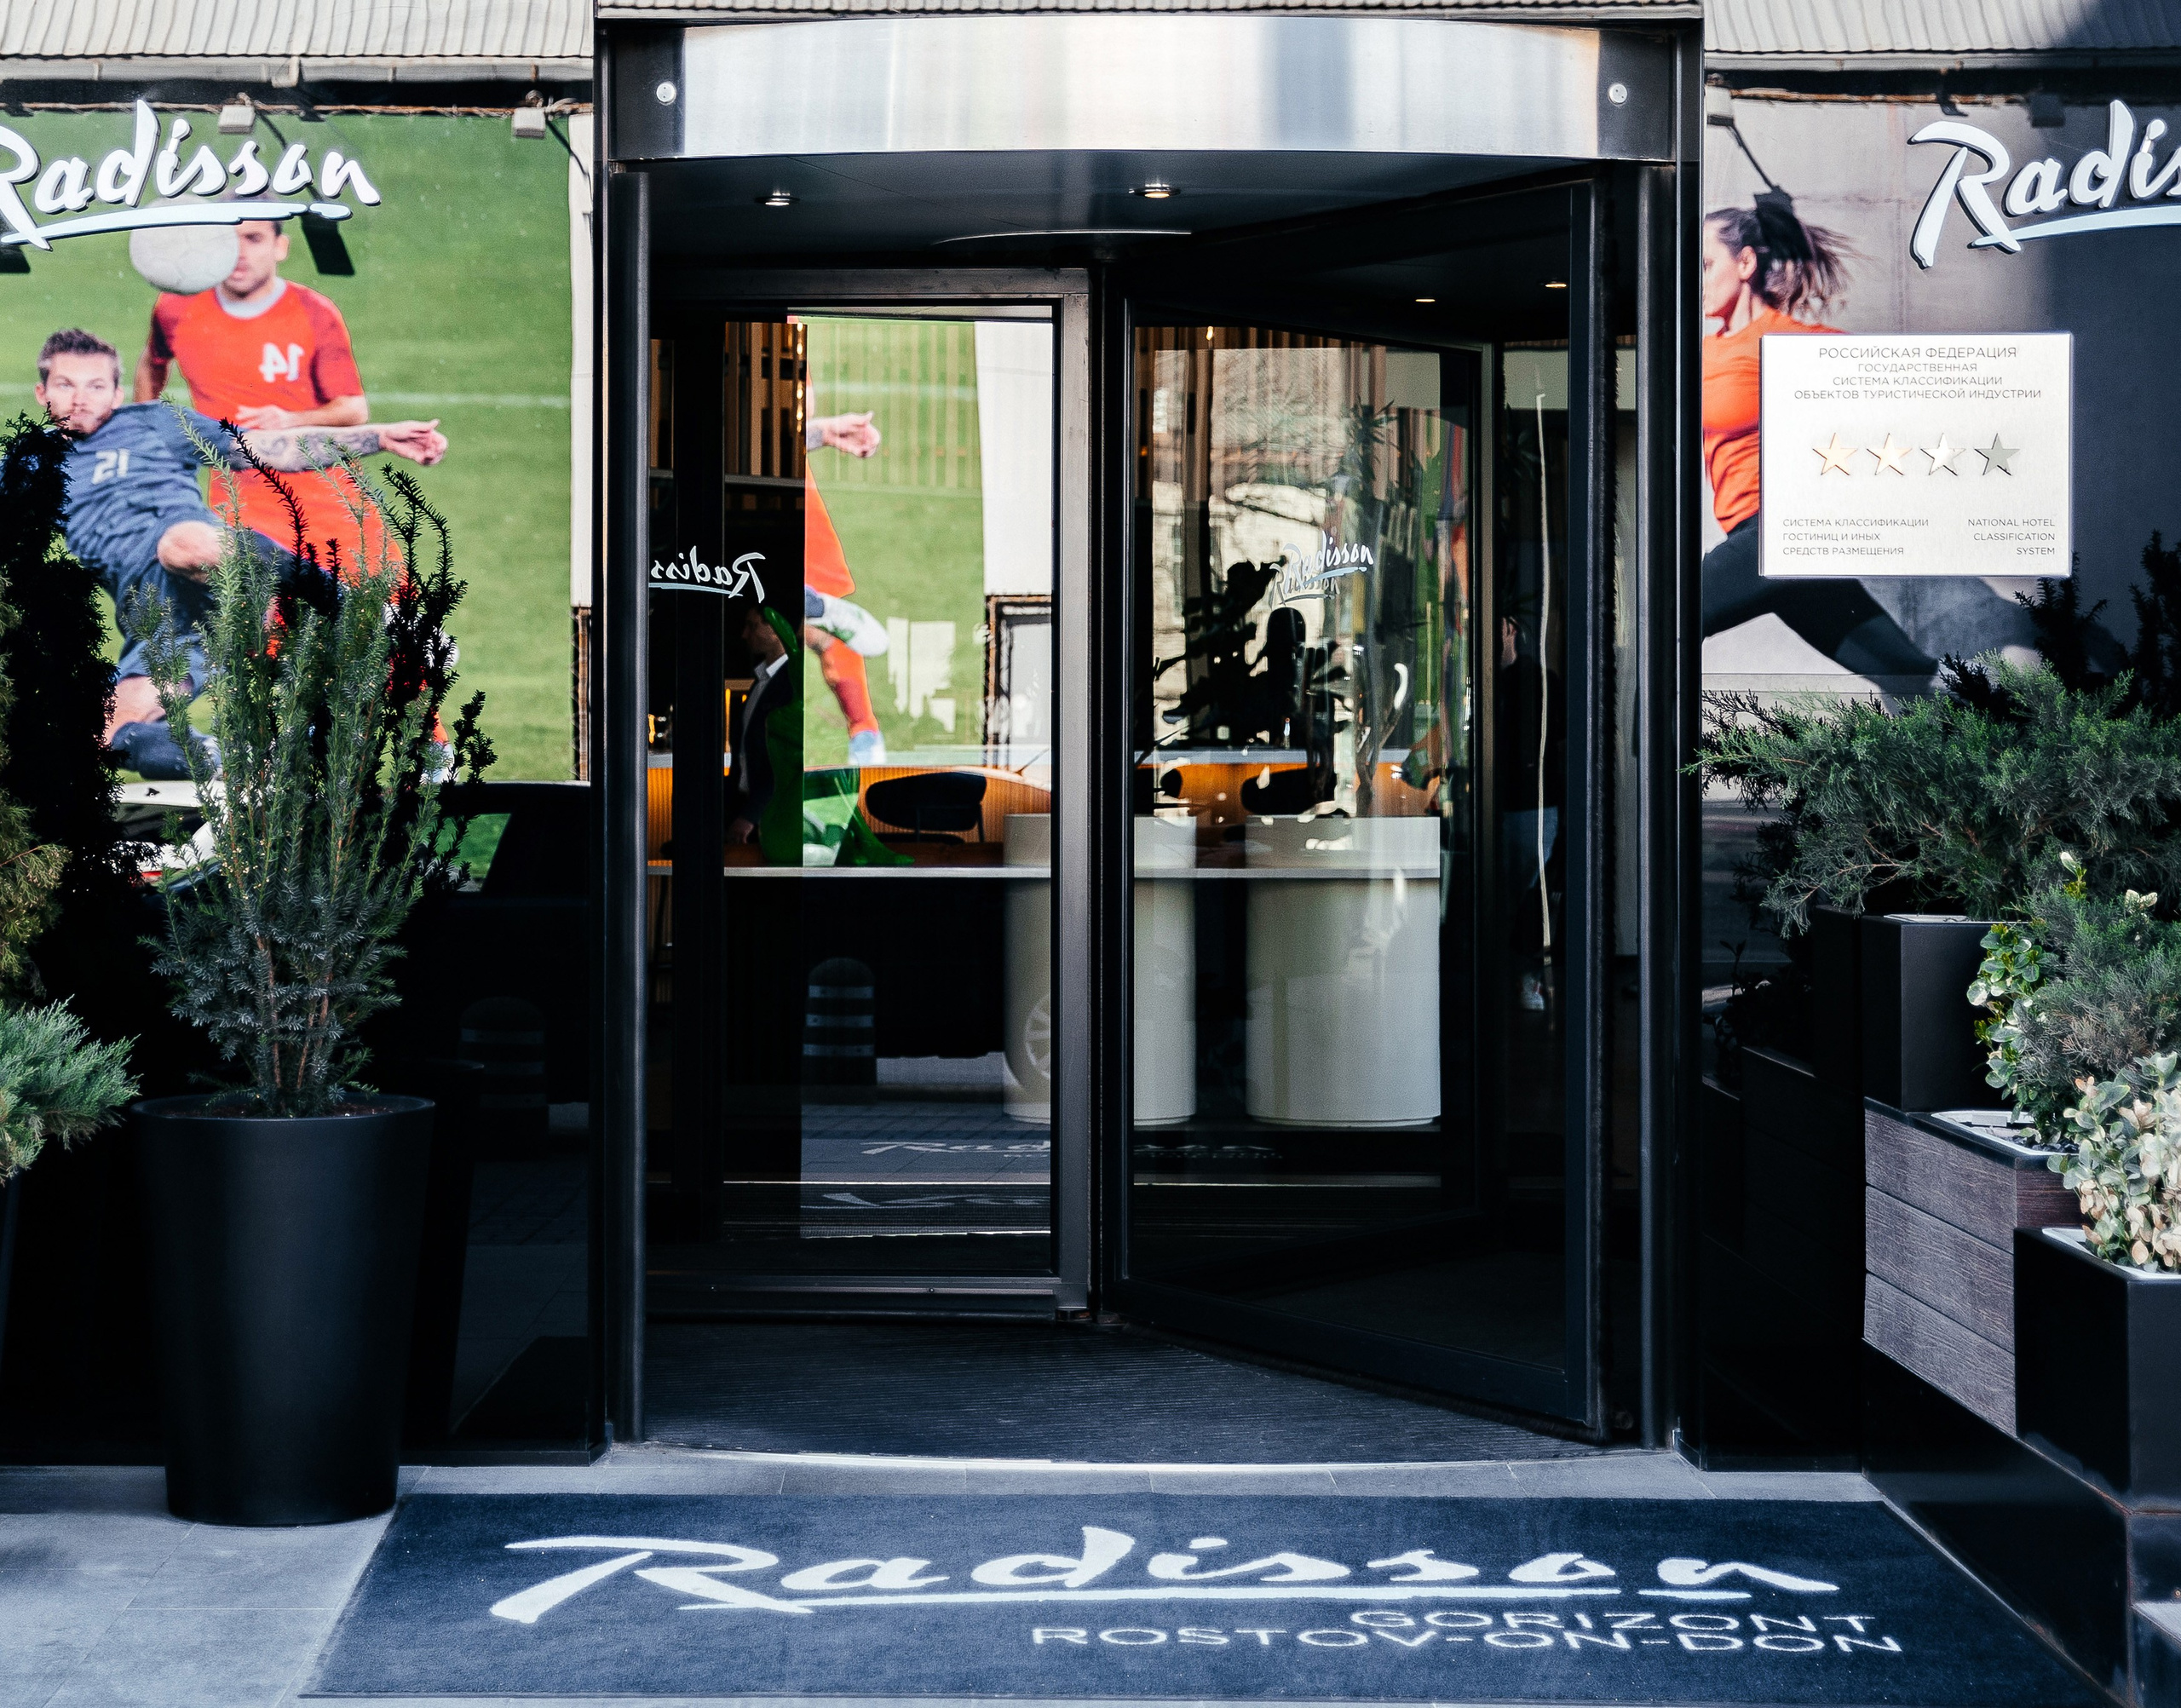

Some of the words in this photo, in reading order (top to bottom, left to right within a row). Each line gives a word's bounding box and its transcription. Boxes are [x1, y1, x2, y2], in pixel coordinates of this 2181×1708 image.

[1818, 345, 1921, 359] РОССИЙСКАЯ
[1925, 347, 2017, 359] ФЕДЕРАЦИЯ
[1857, 363, 1978, 373] ГОСУДАРСТВЕННАЯ
[1833, 377, 1890, 386] СИСТЕМА
[1892, 376, 2003, 386] КЛАССИФИКАЦИИ
[1793, 389, 1860, 400] ОБЪЕКТОВ
[1862, 388, 1965, 400] ТУРИСТИЧЕСКОЙ
[1968, 389, 2042, 400] ИНДУСТРИИ
[1782, 518, 1832, 527] СИСТЕМА
[1834, 518, 1930, 527] КЛАССИФИКАЦИИ
[1967, 518, 2019, 527] NATIONAL
[2022, 518, 2056, 527] HOTEL
[1782, 532, 1839, 542] ГОСТИНИЦ
[1841, 532, 1849, 541] И
[1850, 532, 1881, 541] ИНЫХ
[1973, 532, 2056, 541] CLASSIFICATION
[1782, 547, 1830, 556] СРЕДСТВ
[1832, 547, 1905, 555] РАЗМЕЩЕНИЯ
[2016, 547, 2056, 555] SYSTEM
[1283, 530, 1374, 595] Radisson
[490, 1527, 1839, 1623] Radisson
[1350, 1611, 1875, 1632] GORIZONT
[1032, 1627, 1902, 1652] ROSTOV-ON-DON
